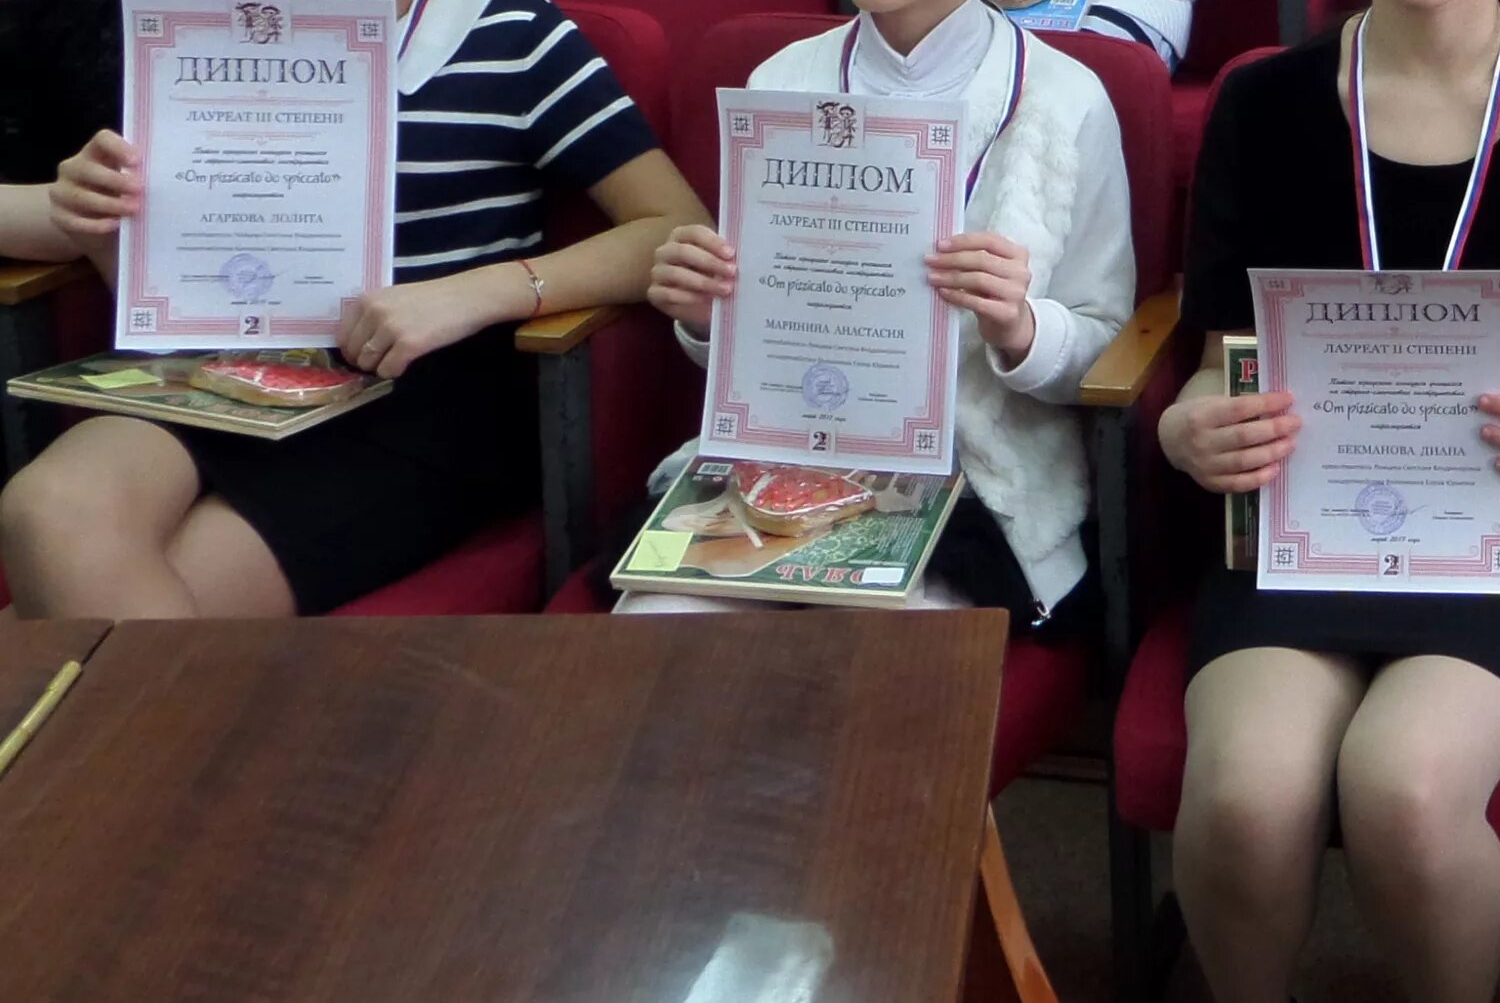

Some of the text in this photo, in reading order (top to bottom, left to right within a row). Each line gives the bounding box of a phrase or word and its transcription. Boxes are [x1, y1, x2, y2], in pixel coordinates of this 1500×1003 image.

[174, 56, 347, 86] ДИПЛОМ
[186, 111, 343, 124] ЛАУРЕАТ III СТЕПЕНИ
[762, 158, 914, 194] ДИПЛОМ
[200, 213, 265, 224] АГАРКОВА
[769, 214, 910, 235] ЛАУРЕАТ III СТЕПЕНИ
[1306, 302, 1480, 324] ДИПЛОМ
[244, 316, 260, 335] 2
[834, 326, 905, 339] АНАСТАСИЯ
[1324, 344, 1389, 354] ЛАУРЕАТ
[1406, 344, 1477, 355] СТЕПЕНИ
[1347, 402, 1398, 420] pizzicato
[1401, 402, 1416, 415] до
[812, 431, 826, 451] 2
[1337, 445, 1466, 457] БЕКМАНОВА ДИАНА
[1384, 554, 1400, 576] 2
